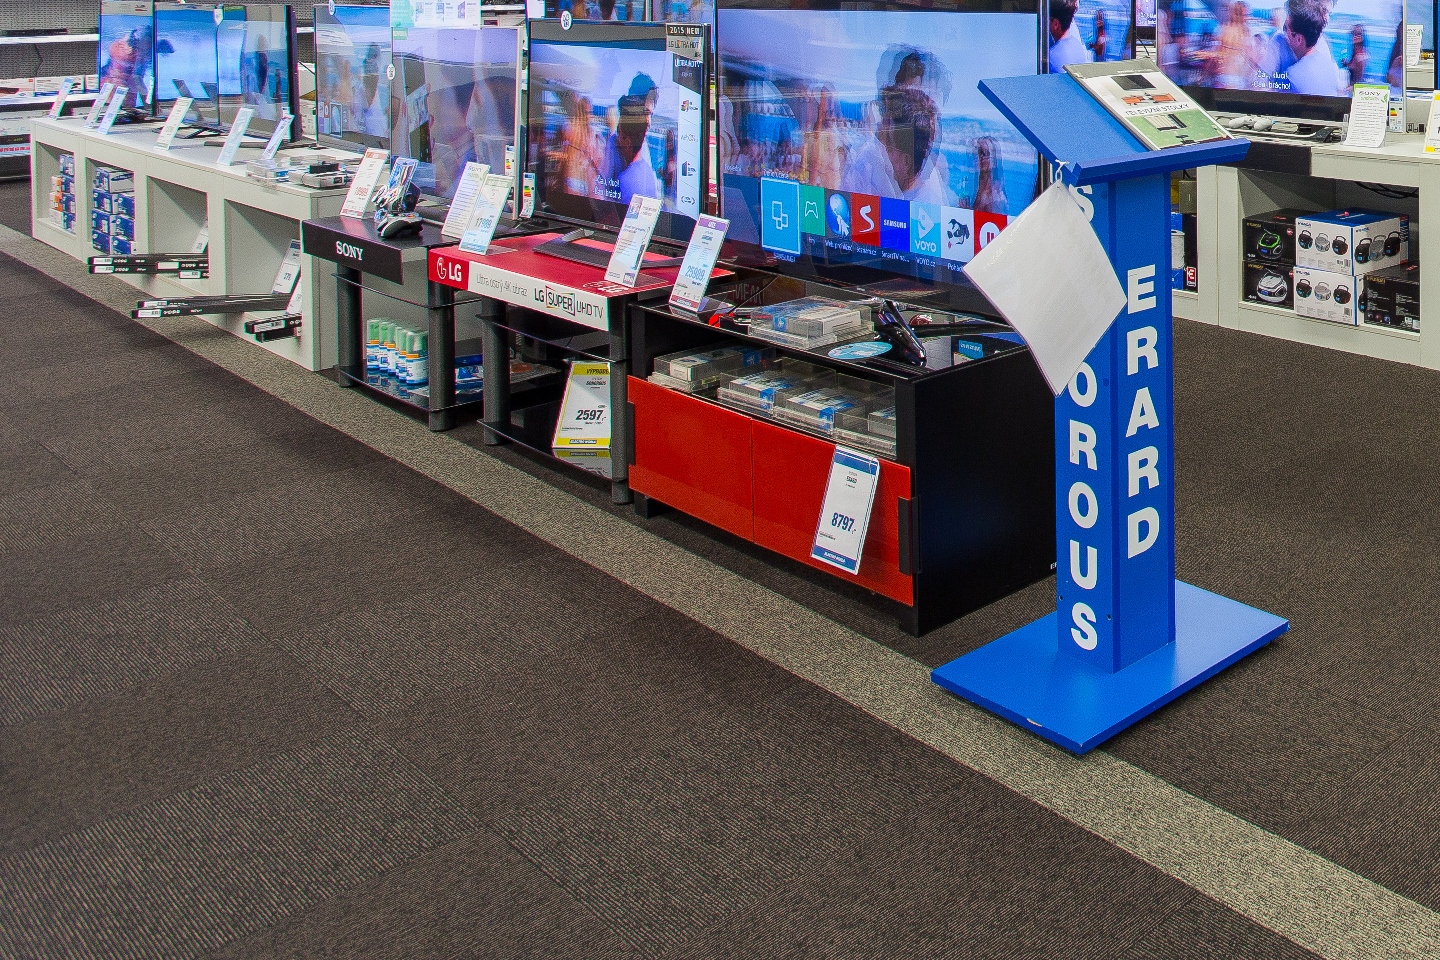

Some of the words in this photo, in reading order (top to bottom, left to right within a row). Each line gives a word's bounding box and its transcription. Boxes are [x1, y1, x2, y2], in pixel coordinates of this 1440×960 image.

[883, 218, 907, 229] SAMSUNG
[336, 240, 364, 261] SONY
[914, 239, 937, 253] VOYO
[448, 261, 462, 282] LG
[534, 287, 545, 303] LG
[548, 290, 573, 312] SUPER
[1068, 184, 1100, 651] SOROUS
[1125, 263, 1160, 560] ERARD
